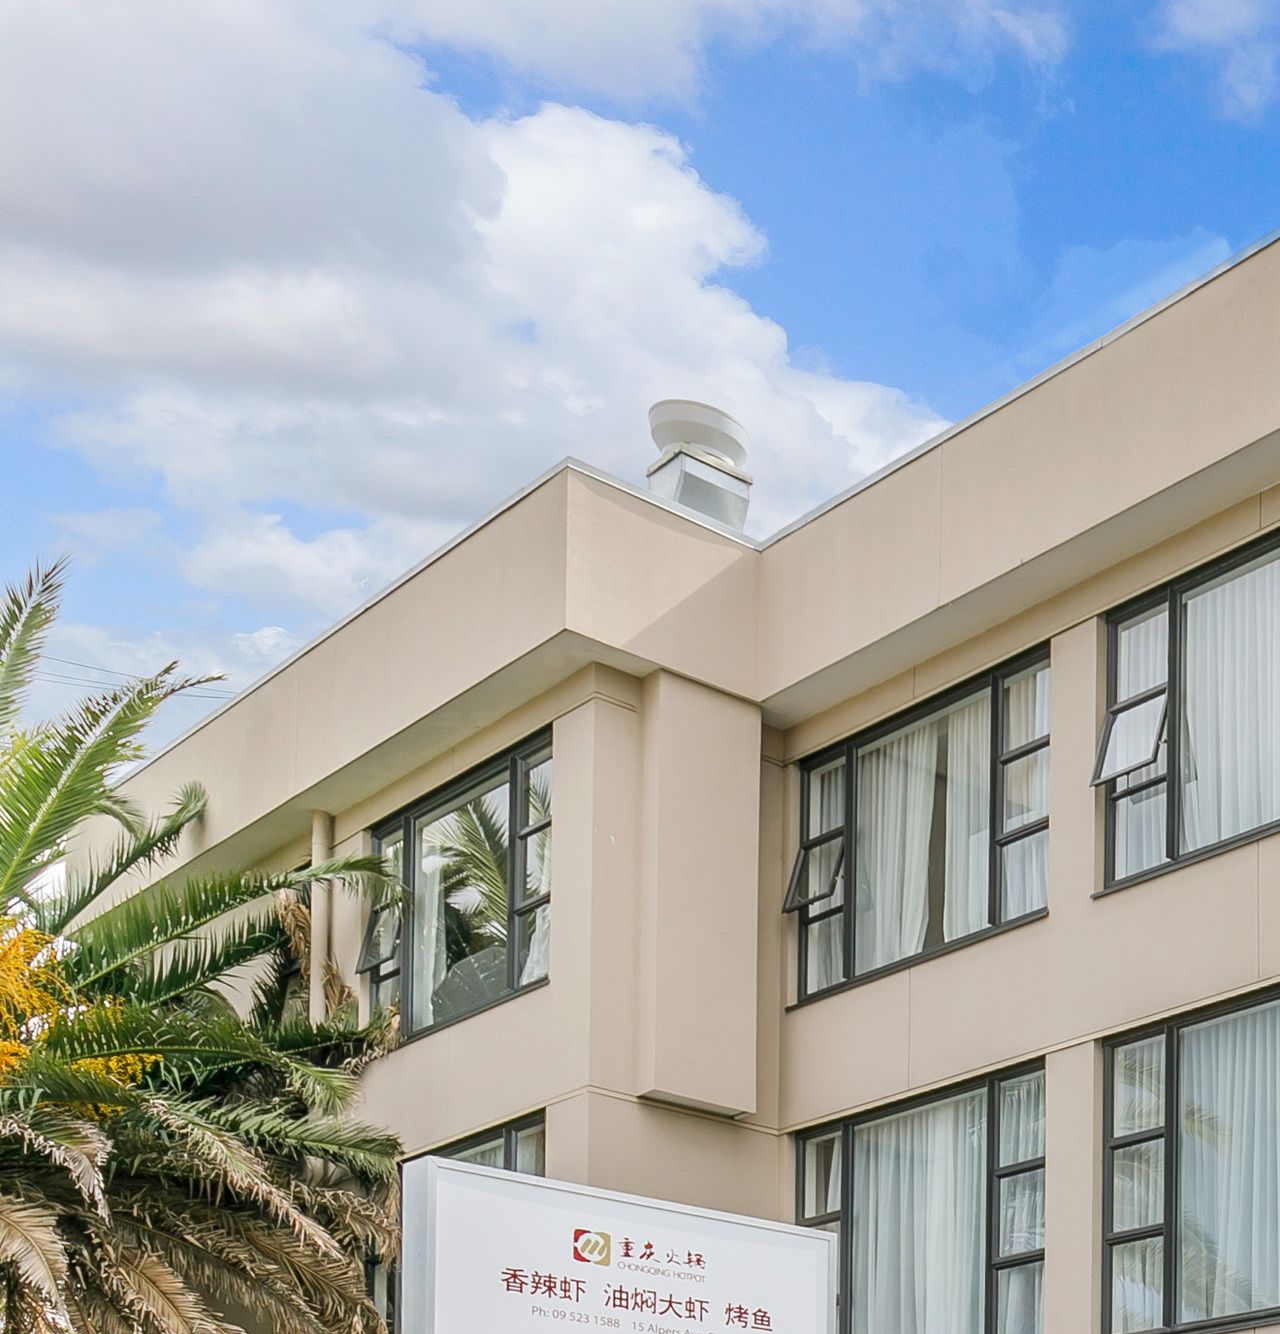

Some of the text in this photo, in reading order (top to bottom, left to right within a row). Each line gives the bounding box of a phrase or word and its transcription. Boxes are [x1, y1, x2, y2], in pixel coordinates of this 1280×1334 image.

[617, 1261, 706, 1283] CHONGQING HOTPOT
[501, 1267, 773, 1332] 香辣虾 油焖大虾 烤鱼
[531, 1305, 549, 1318] Ph:
[552, 1309, 566, 1320] 09
[569, 1312, 590, 1323] 523
[594, 1315, 620, 1328] 1588
[632, 1321, 644, 1332] 15
